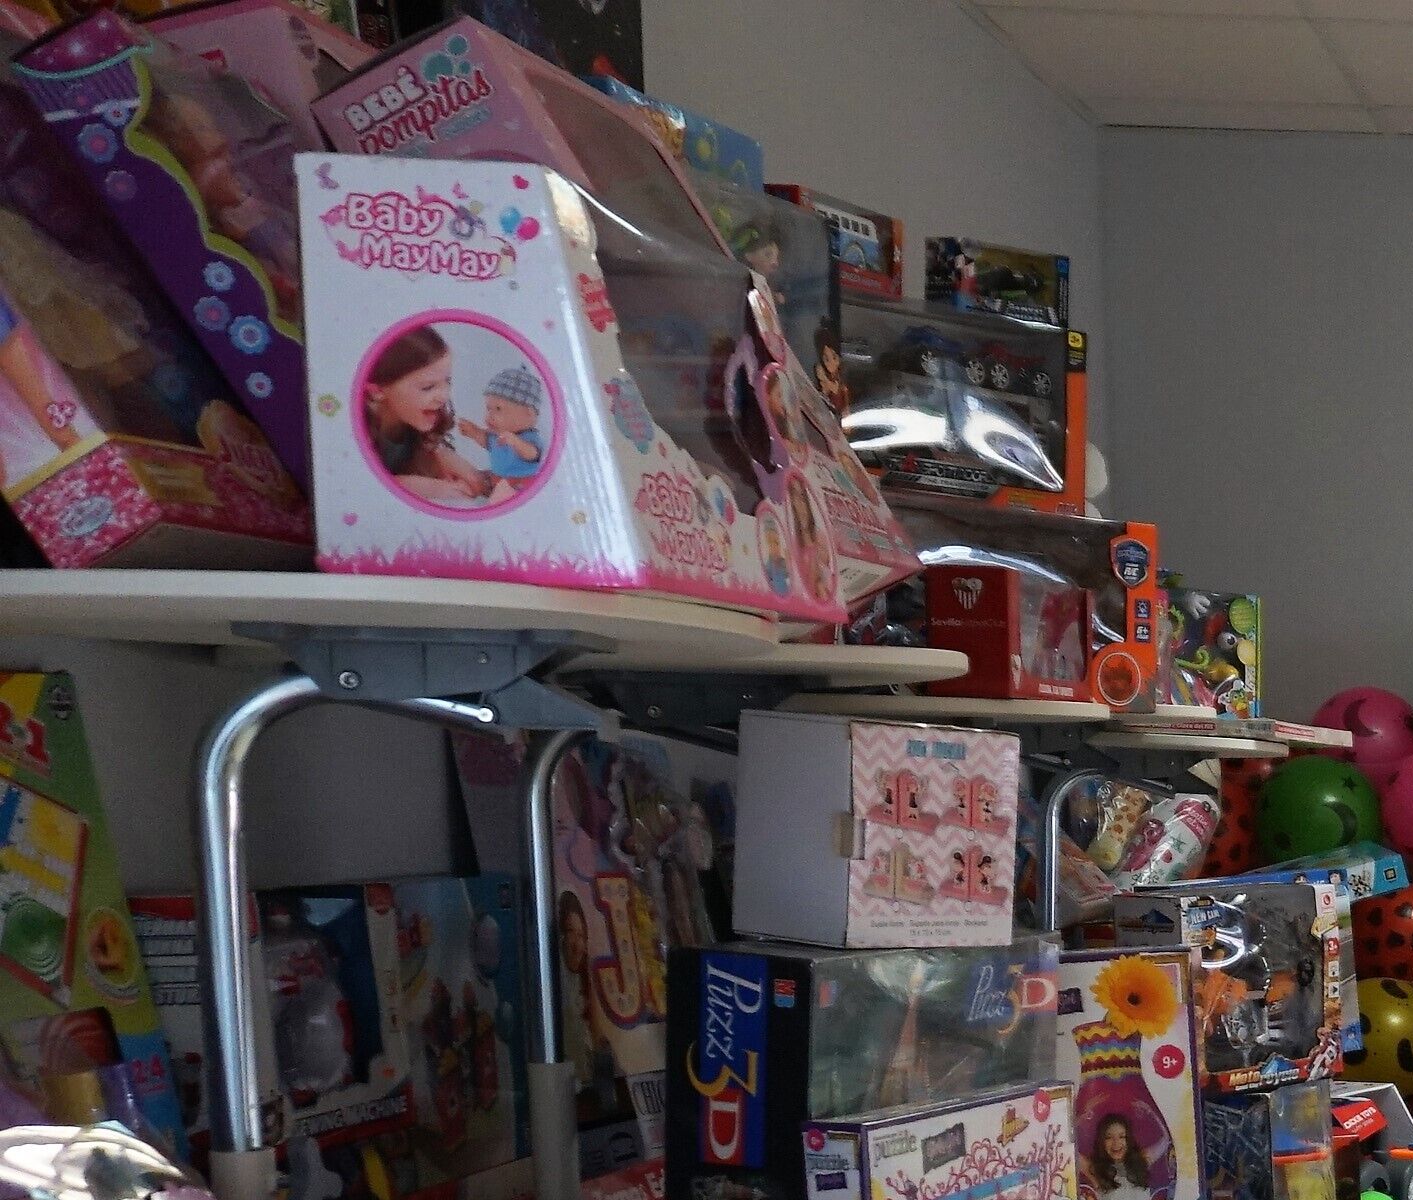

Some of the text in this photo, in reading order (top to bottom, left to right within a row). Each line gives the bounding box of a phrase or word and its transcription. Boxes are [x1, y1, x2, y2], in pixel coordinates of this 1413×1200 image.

[346, 192, 445, 238] Baby
[360, 232, 502, 281] MayMay
[706, 963, 763, 1061] Puzz
